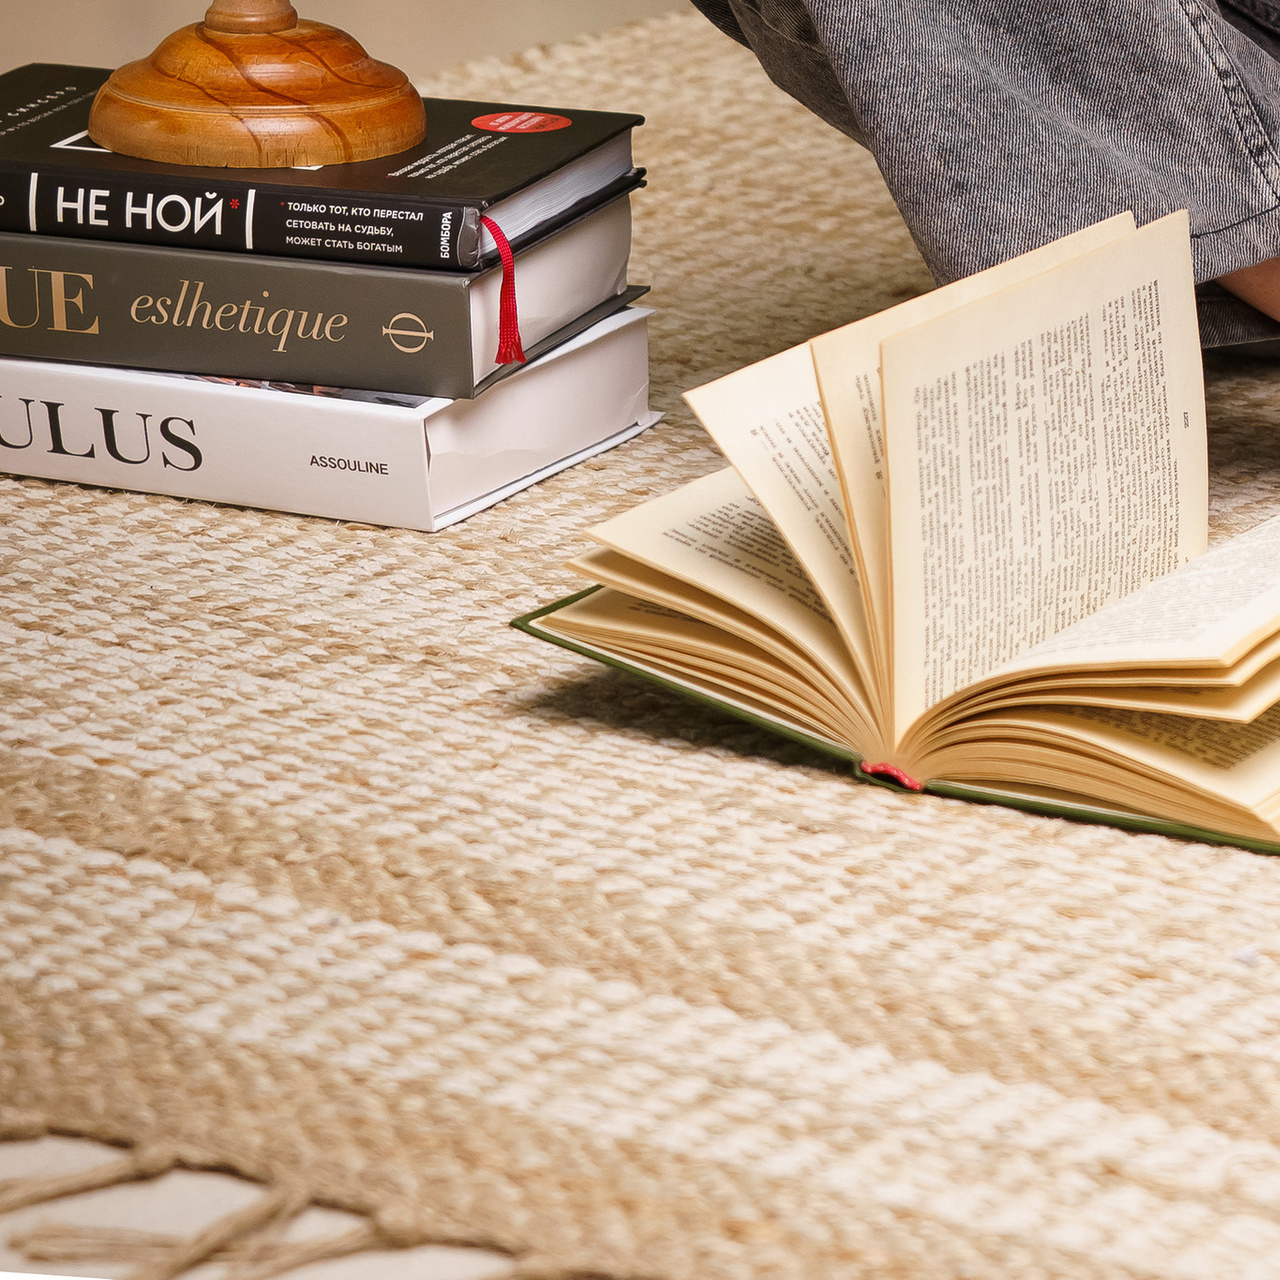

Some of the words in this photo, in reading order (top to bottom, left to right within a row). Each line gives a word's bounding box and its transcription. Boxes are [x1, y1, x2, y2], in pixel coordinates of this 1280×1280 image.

[57, 186, 110, 226] НЕ
[288, 201, 327, 214] ТОЛЬКО
[329, 205, 349, 217] ТОТ,
[351, 207, 370, 218] КТО
[373, 209, 424, 222] ПЕРЕСТАЛ
[286, 219, 336, 232] СЕТОВАТЬ
[338, 222, 352, 233] НА
[354, 225, 394, 238] СУДЬБУ,
[440, 211, 453, 259] БОМБОРА
[286, 236, 322, 248] МОЖЕТ
[324, 239, 355, 251] СТАТЬ
[356, 241, 403, 254] БОГАТЫМ
[310, 455, 389, 476] ASSOULINE
